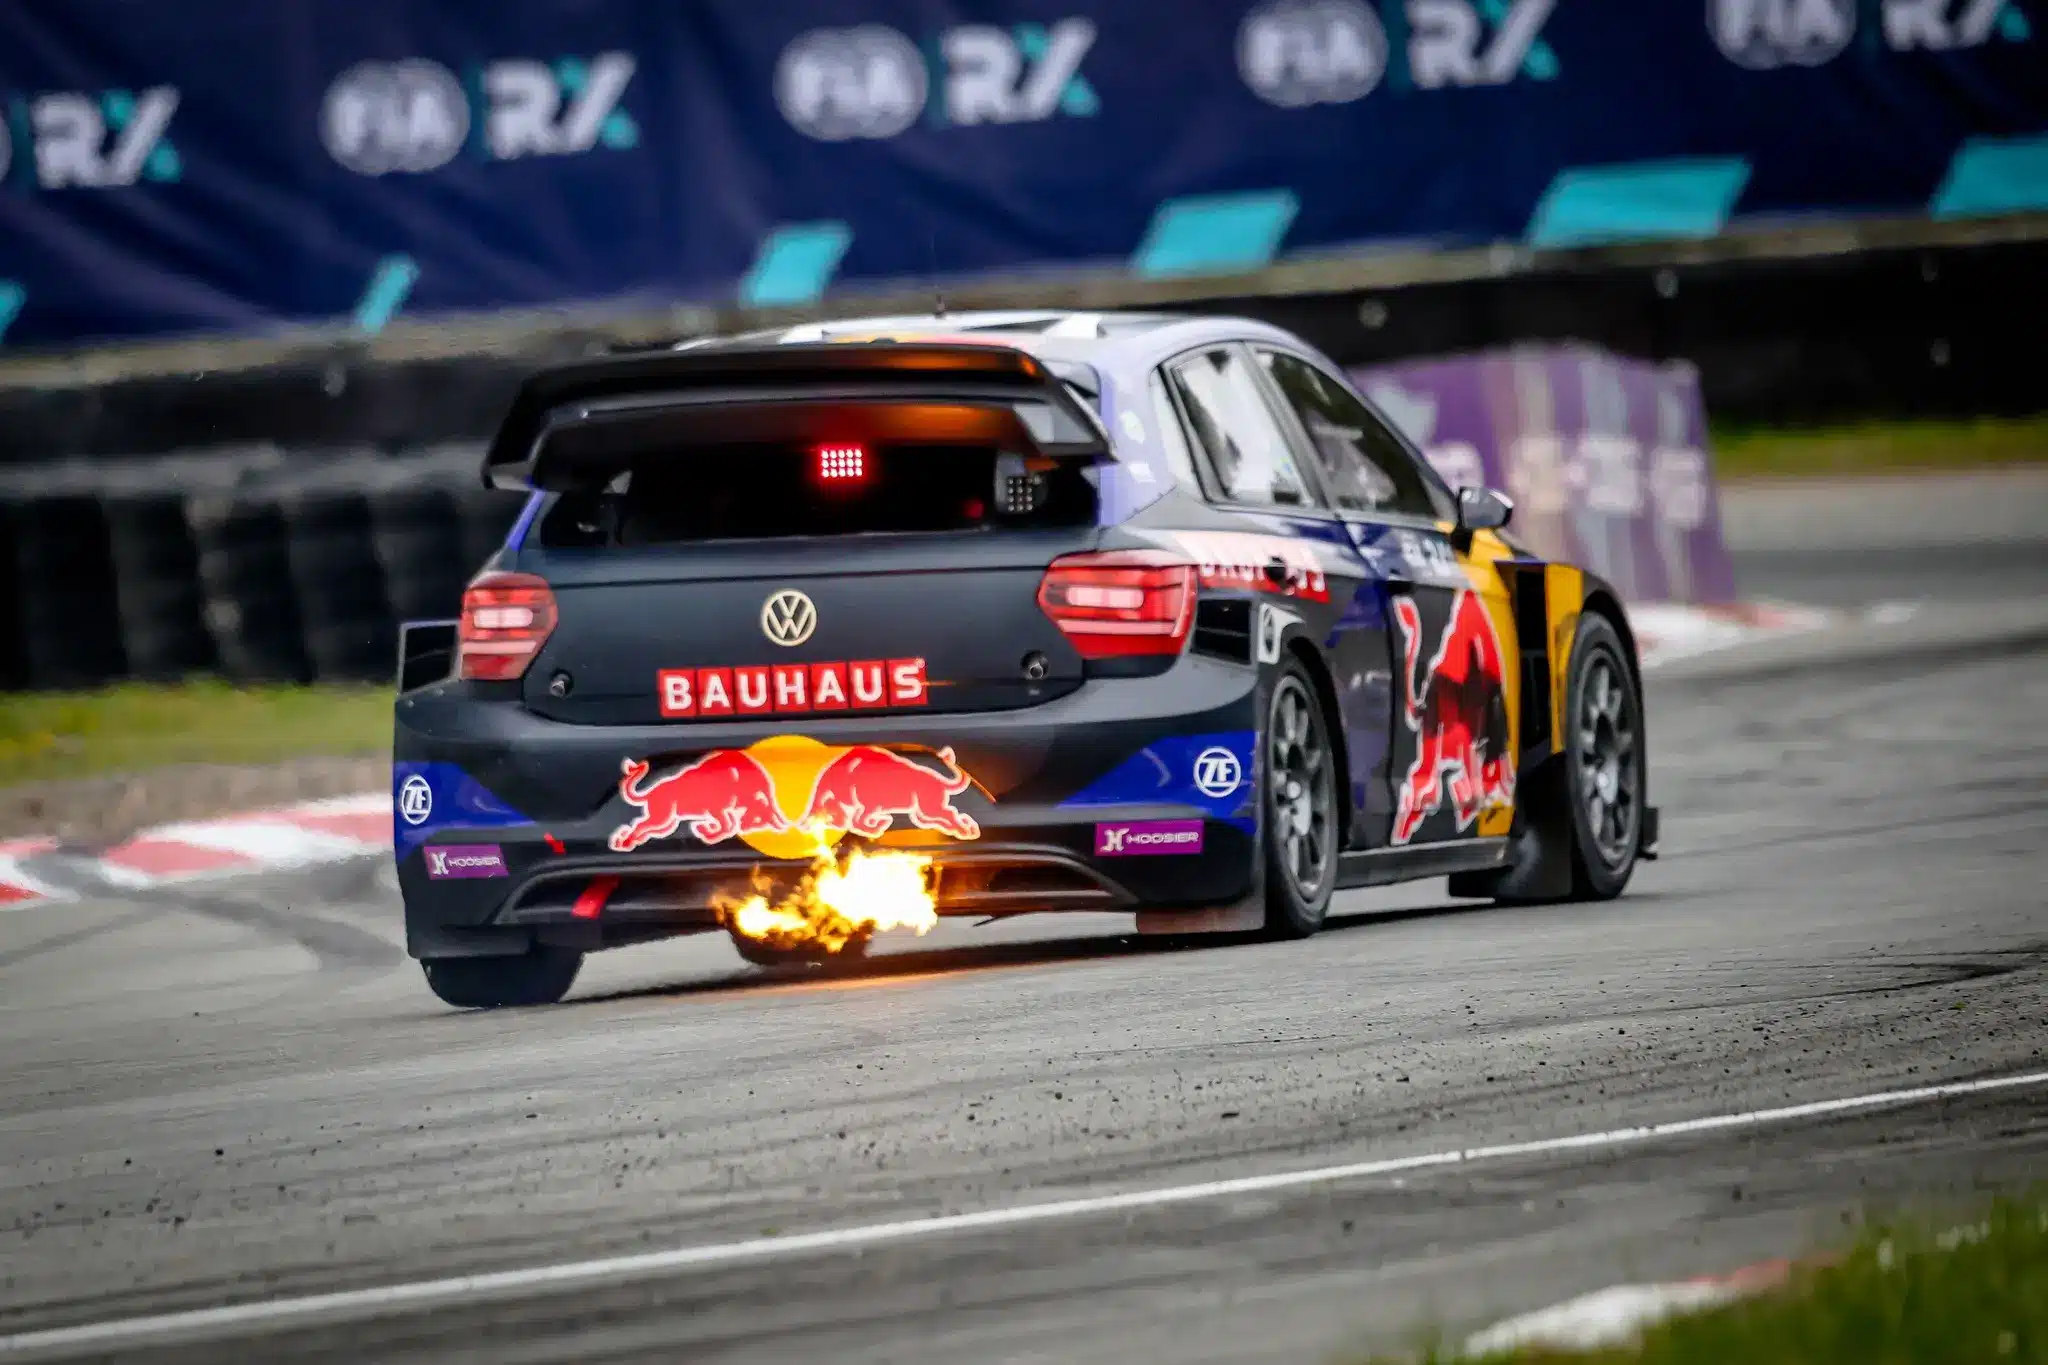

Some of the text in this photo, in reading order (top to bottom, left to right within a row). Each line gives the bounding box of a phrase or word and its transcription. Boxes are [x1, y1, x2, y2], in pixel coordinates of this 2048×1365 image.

[665, 663, 923, 710] BAUHAUS
[1126, 831, 1199, 845] HOOSIER
[448, 856, 501, 867] HOOSIER
